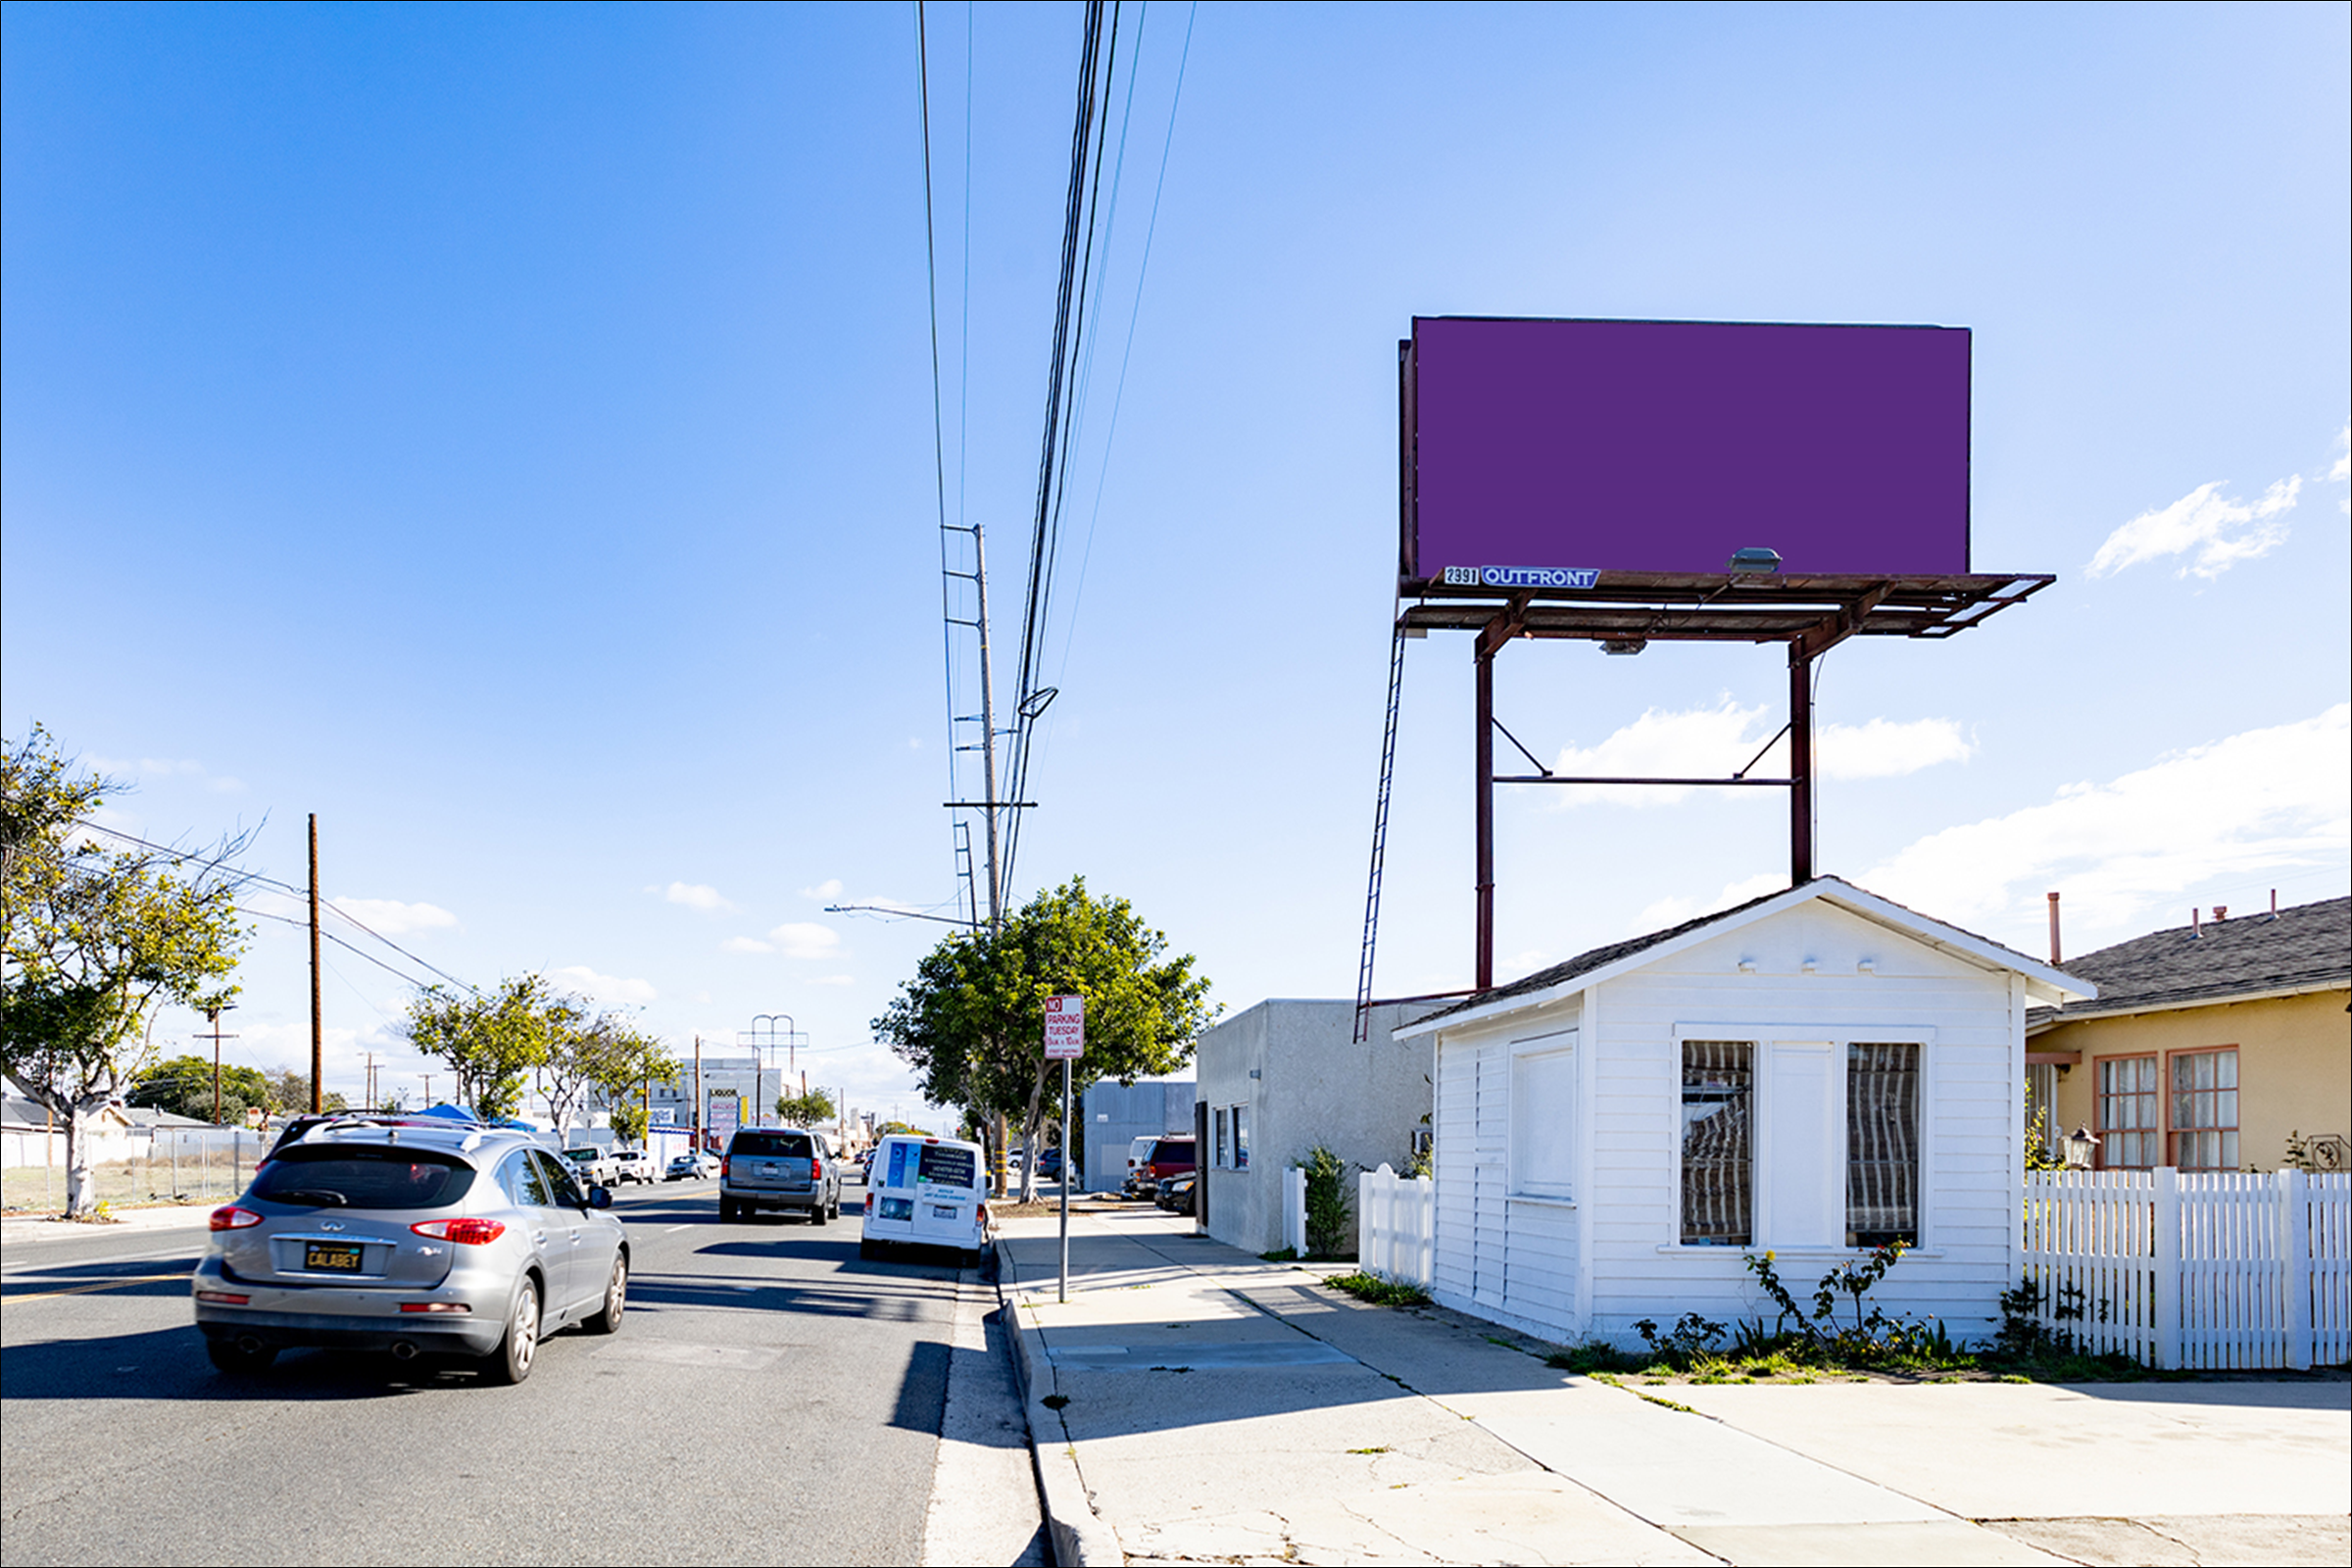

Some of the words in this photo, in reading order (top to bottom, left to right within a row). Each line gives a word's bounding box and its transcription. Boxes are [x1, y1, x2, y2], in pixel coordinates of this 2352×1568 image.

[1485, 568, 1593, 585] OUTFRONT
[1049, 1000, 1060, 1011] NO
[1049, 1013, 1080, 1024] PARKING
[1049, 1026, 1079, 1035] TUESDAY
